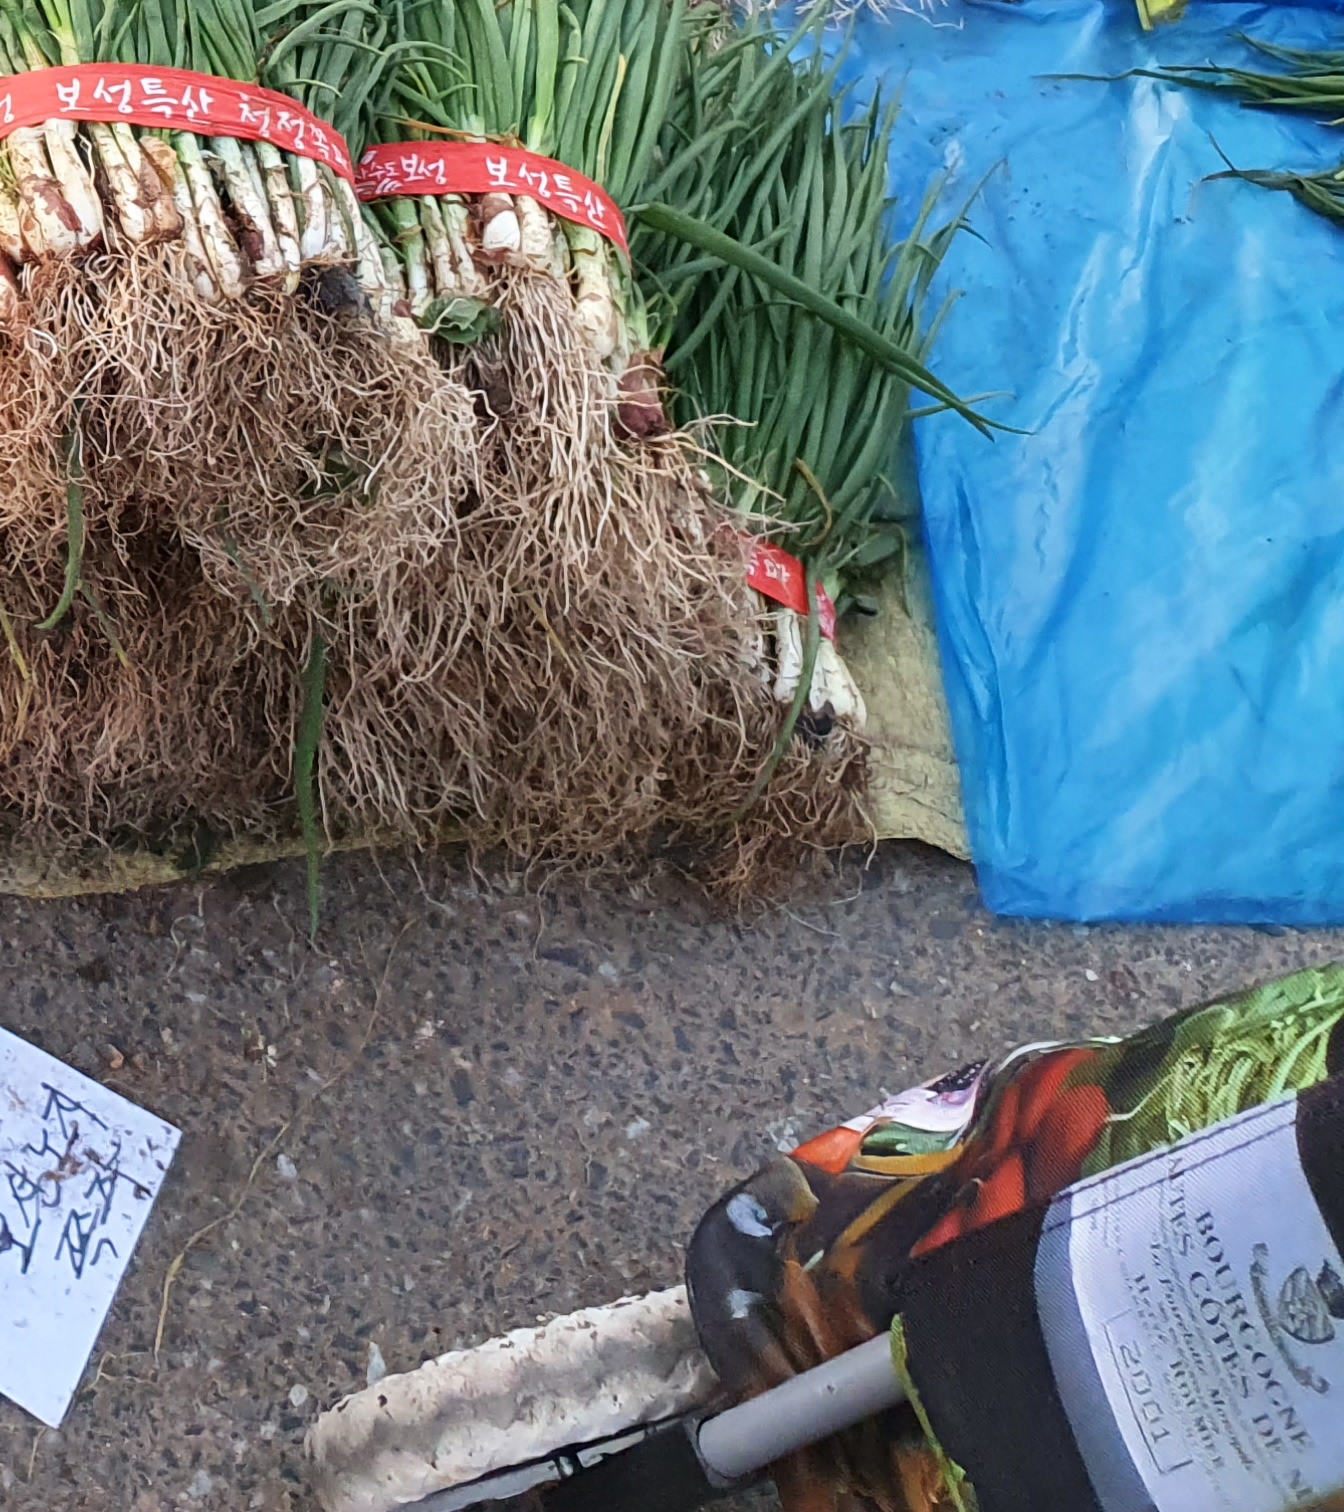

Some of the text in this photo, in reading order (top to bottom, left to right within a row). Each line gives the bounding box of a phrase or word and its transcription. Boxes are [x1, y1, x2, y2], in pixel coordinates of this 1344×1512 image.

[56, 79, 213, 125] 보성특산
[240, 95, 349, 171] 청정쪽파
[400, 154, 447, 185] 보성
[486, 156, 607, 229] 보성특산
[1185, 1266, 1258, 1404] CÔTES
[1194, 1209, 1314, 1456] BOURGOGNE
[1120, 1344, 1171, 1445] 2001
